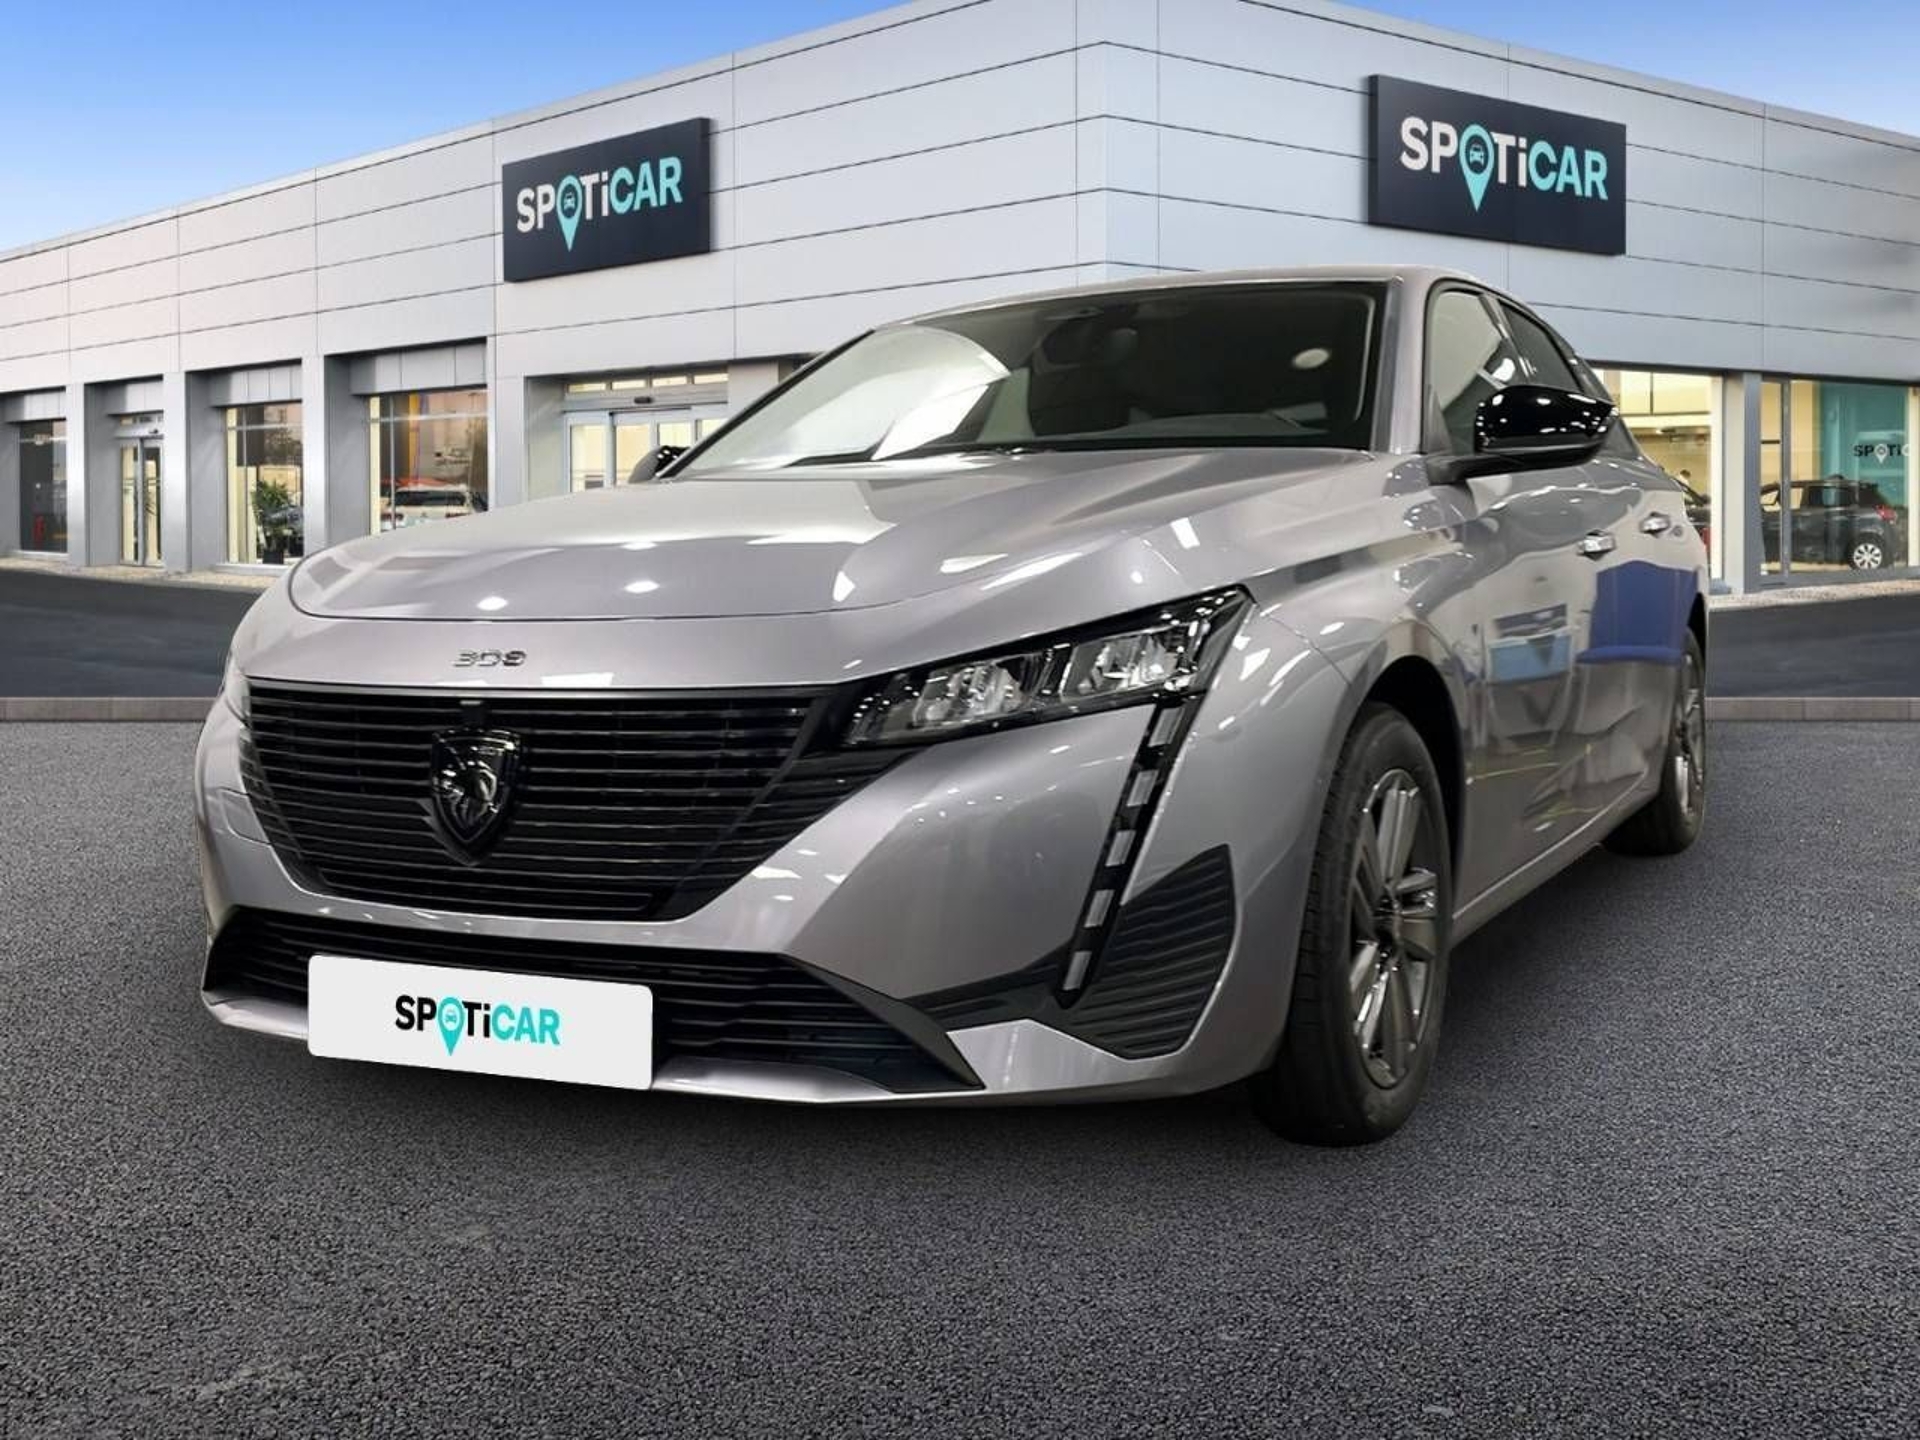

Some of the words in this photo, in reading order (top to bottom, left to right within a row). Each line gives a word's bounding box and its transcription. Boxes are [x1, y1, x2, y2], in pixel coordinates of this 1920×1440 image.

[516, 156, 683, 252] SPOTiCAR
[1400, 116, 1608, 212] SPOTiCAR
[395, 994, 560, 1056] SPOTiCAR
